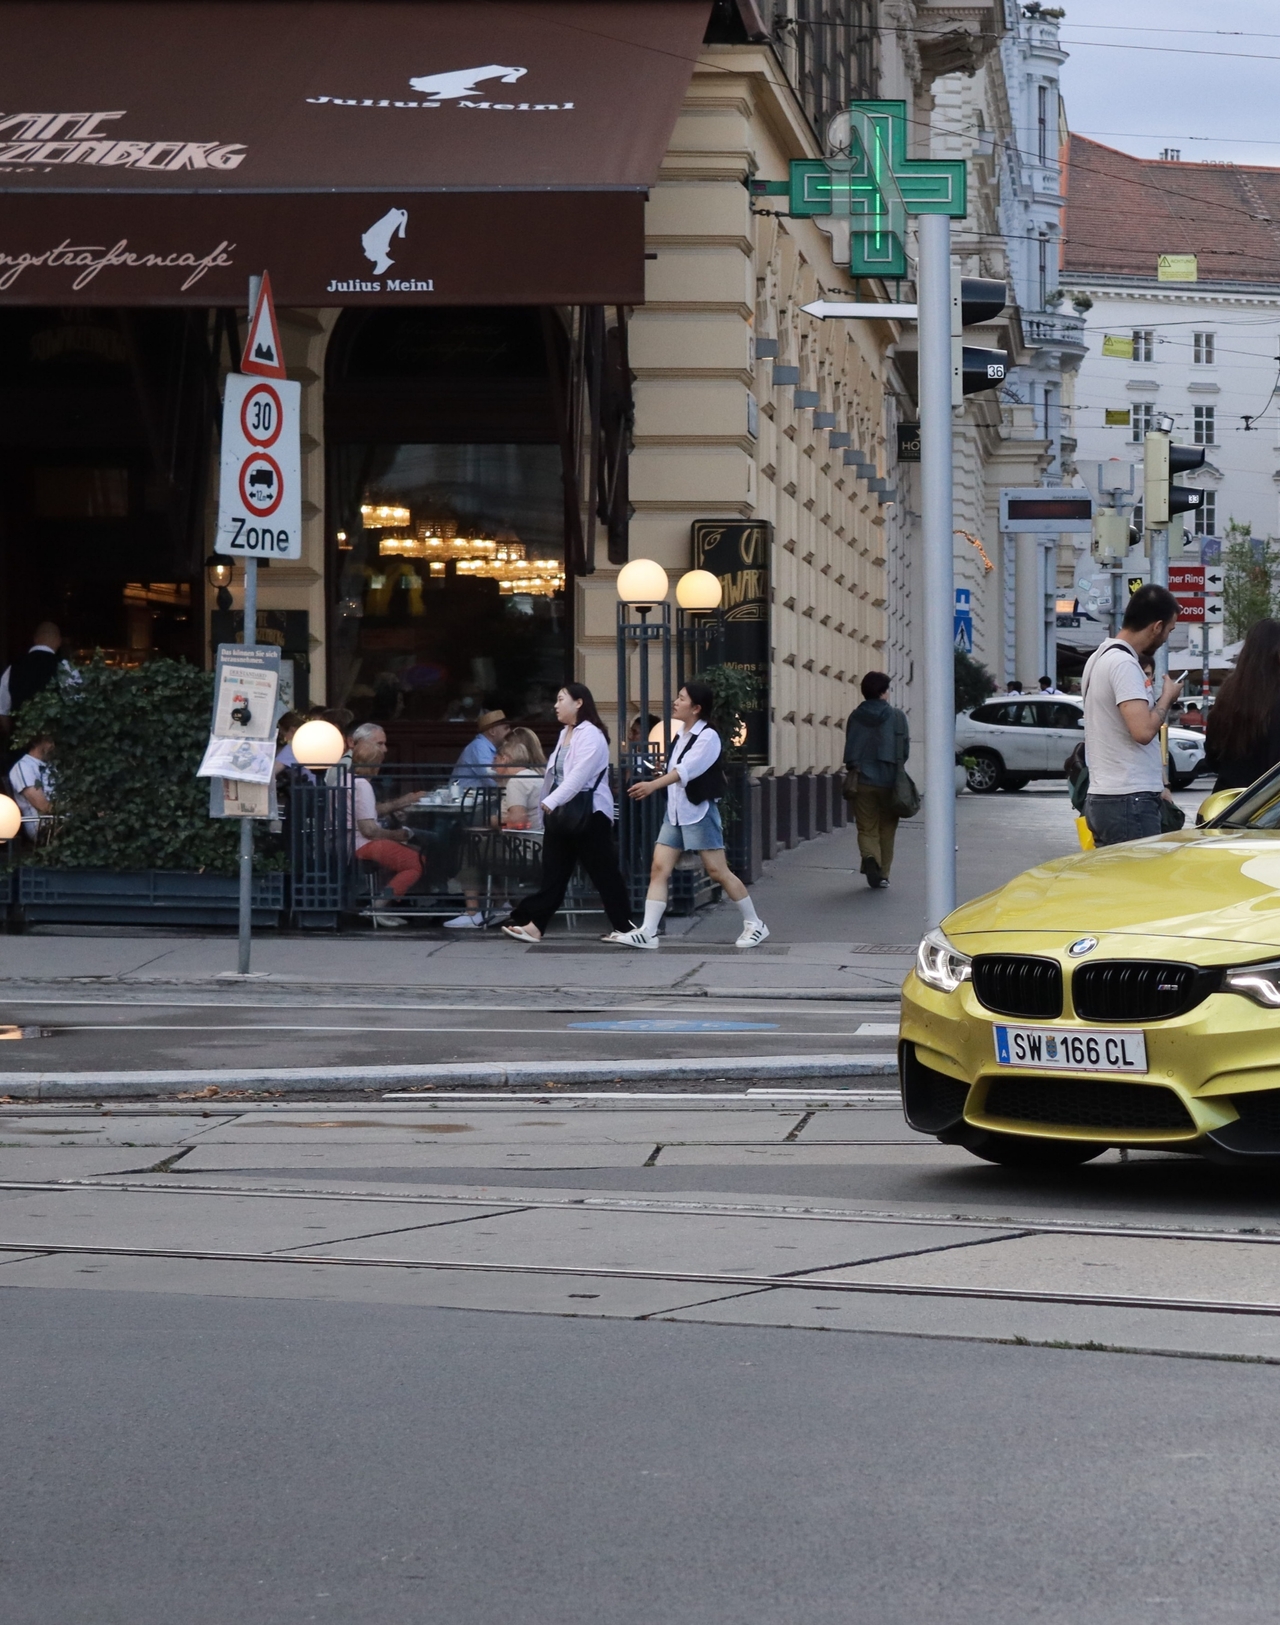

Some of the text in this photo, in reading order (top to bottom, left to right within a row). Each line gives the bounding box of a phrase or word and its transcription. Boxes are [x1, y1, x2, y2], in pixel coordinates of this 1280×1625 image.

[306, 96, 576, 111] Julius Meinl
[327, 279, 434, 292] Julius Meinl
[988, 366, 1003, 377] 36
[252, 401, 271, 431] 30
[230, 517, 289, 552] Zone
[1185, 574, 1204, 585] Ring
[722, 661, 757, 671] Wiens
[1001, 1049, 1008, 1059] A
[1013, 1033, 1135, 1066] SW 166 CL
